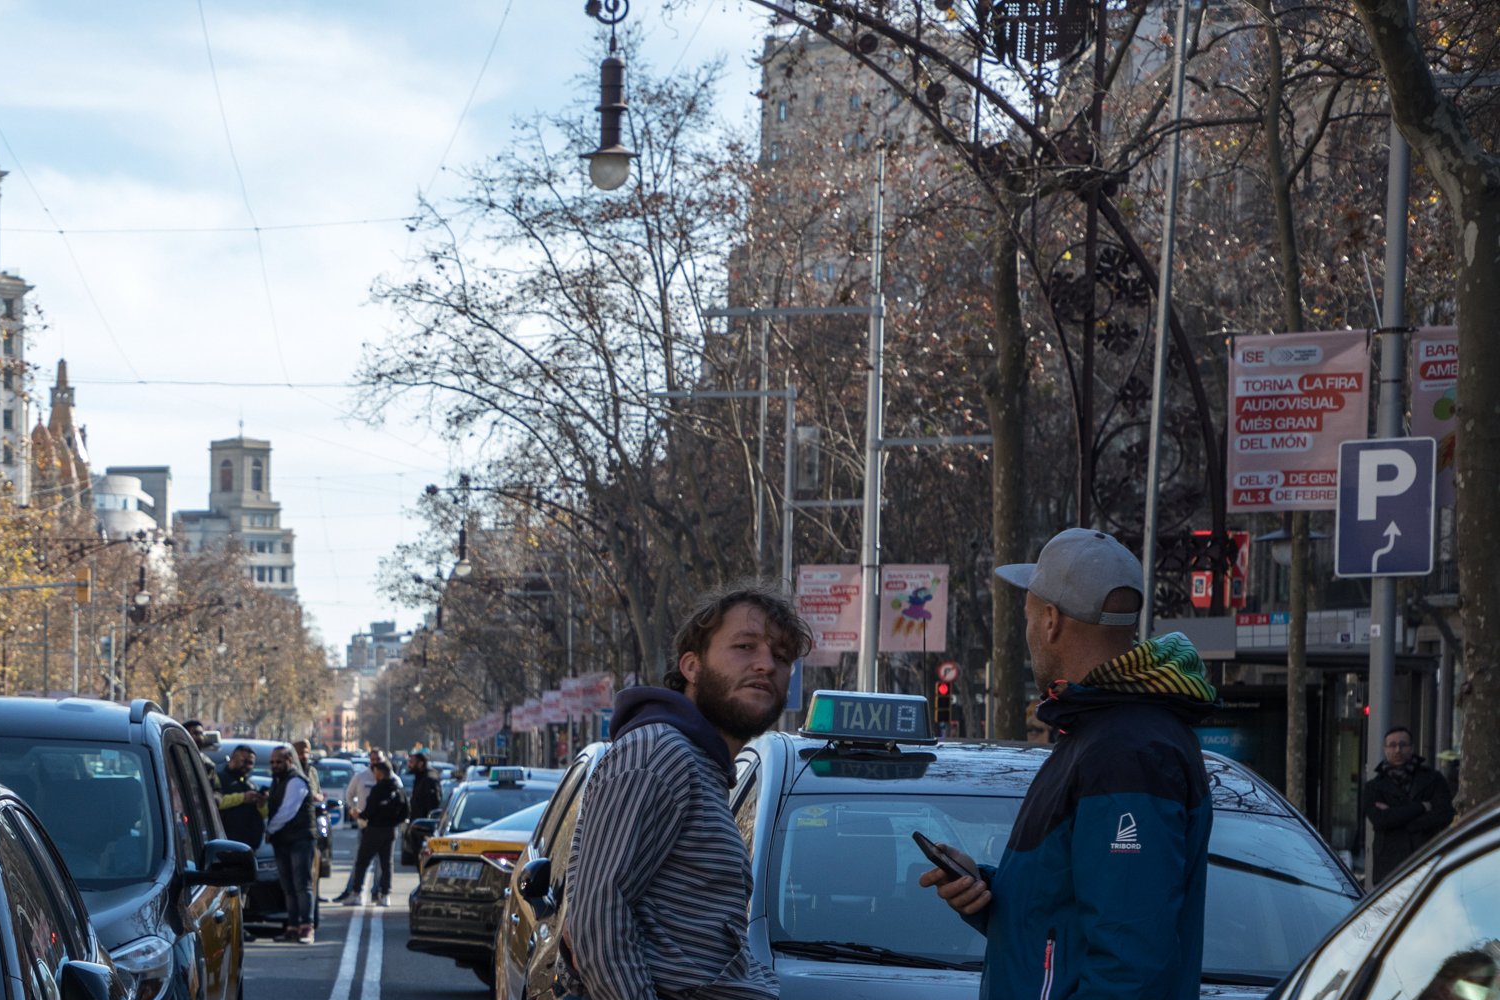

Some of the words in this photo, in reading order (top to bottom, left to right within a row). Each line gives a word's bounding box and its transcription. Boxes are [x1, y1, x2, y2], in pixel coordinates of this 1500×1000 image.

[1242, 351, 1265, 363] ISE
[1243, 380, 1294, 392] TORNA
[1303, 378, 1324, 390] LA
[1326, 376, 1358, 389] FIRA
[1242, 397, 1339, 412] AUDIOVISUAL
[1241, 416, 1272, 431] MÉS
[1275, 416, 1317, 430] GRAN
[1240, 437, 1267, 450] DEL
[1271, 433, 1307, 449] MÓN
[1240, 475, 1262, 486] DEL
[1268, 474, 1279, 484] 31
[1290, 473, 1307, 484] DE
[1358, 449, 1417, 520] P
[1238, 492, 1255, 503] AL
[1258, 491, 1266, 501] 3
[1275, 489, 1292, 501] DE
[840, 702, 891, 731] TAXI
[1203, 735, 1229, 745] TACO
